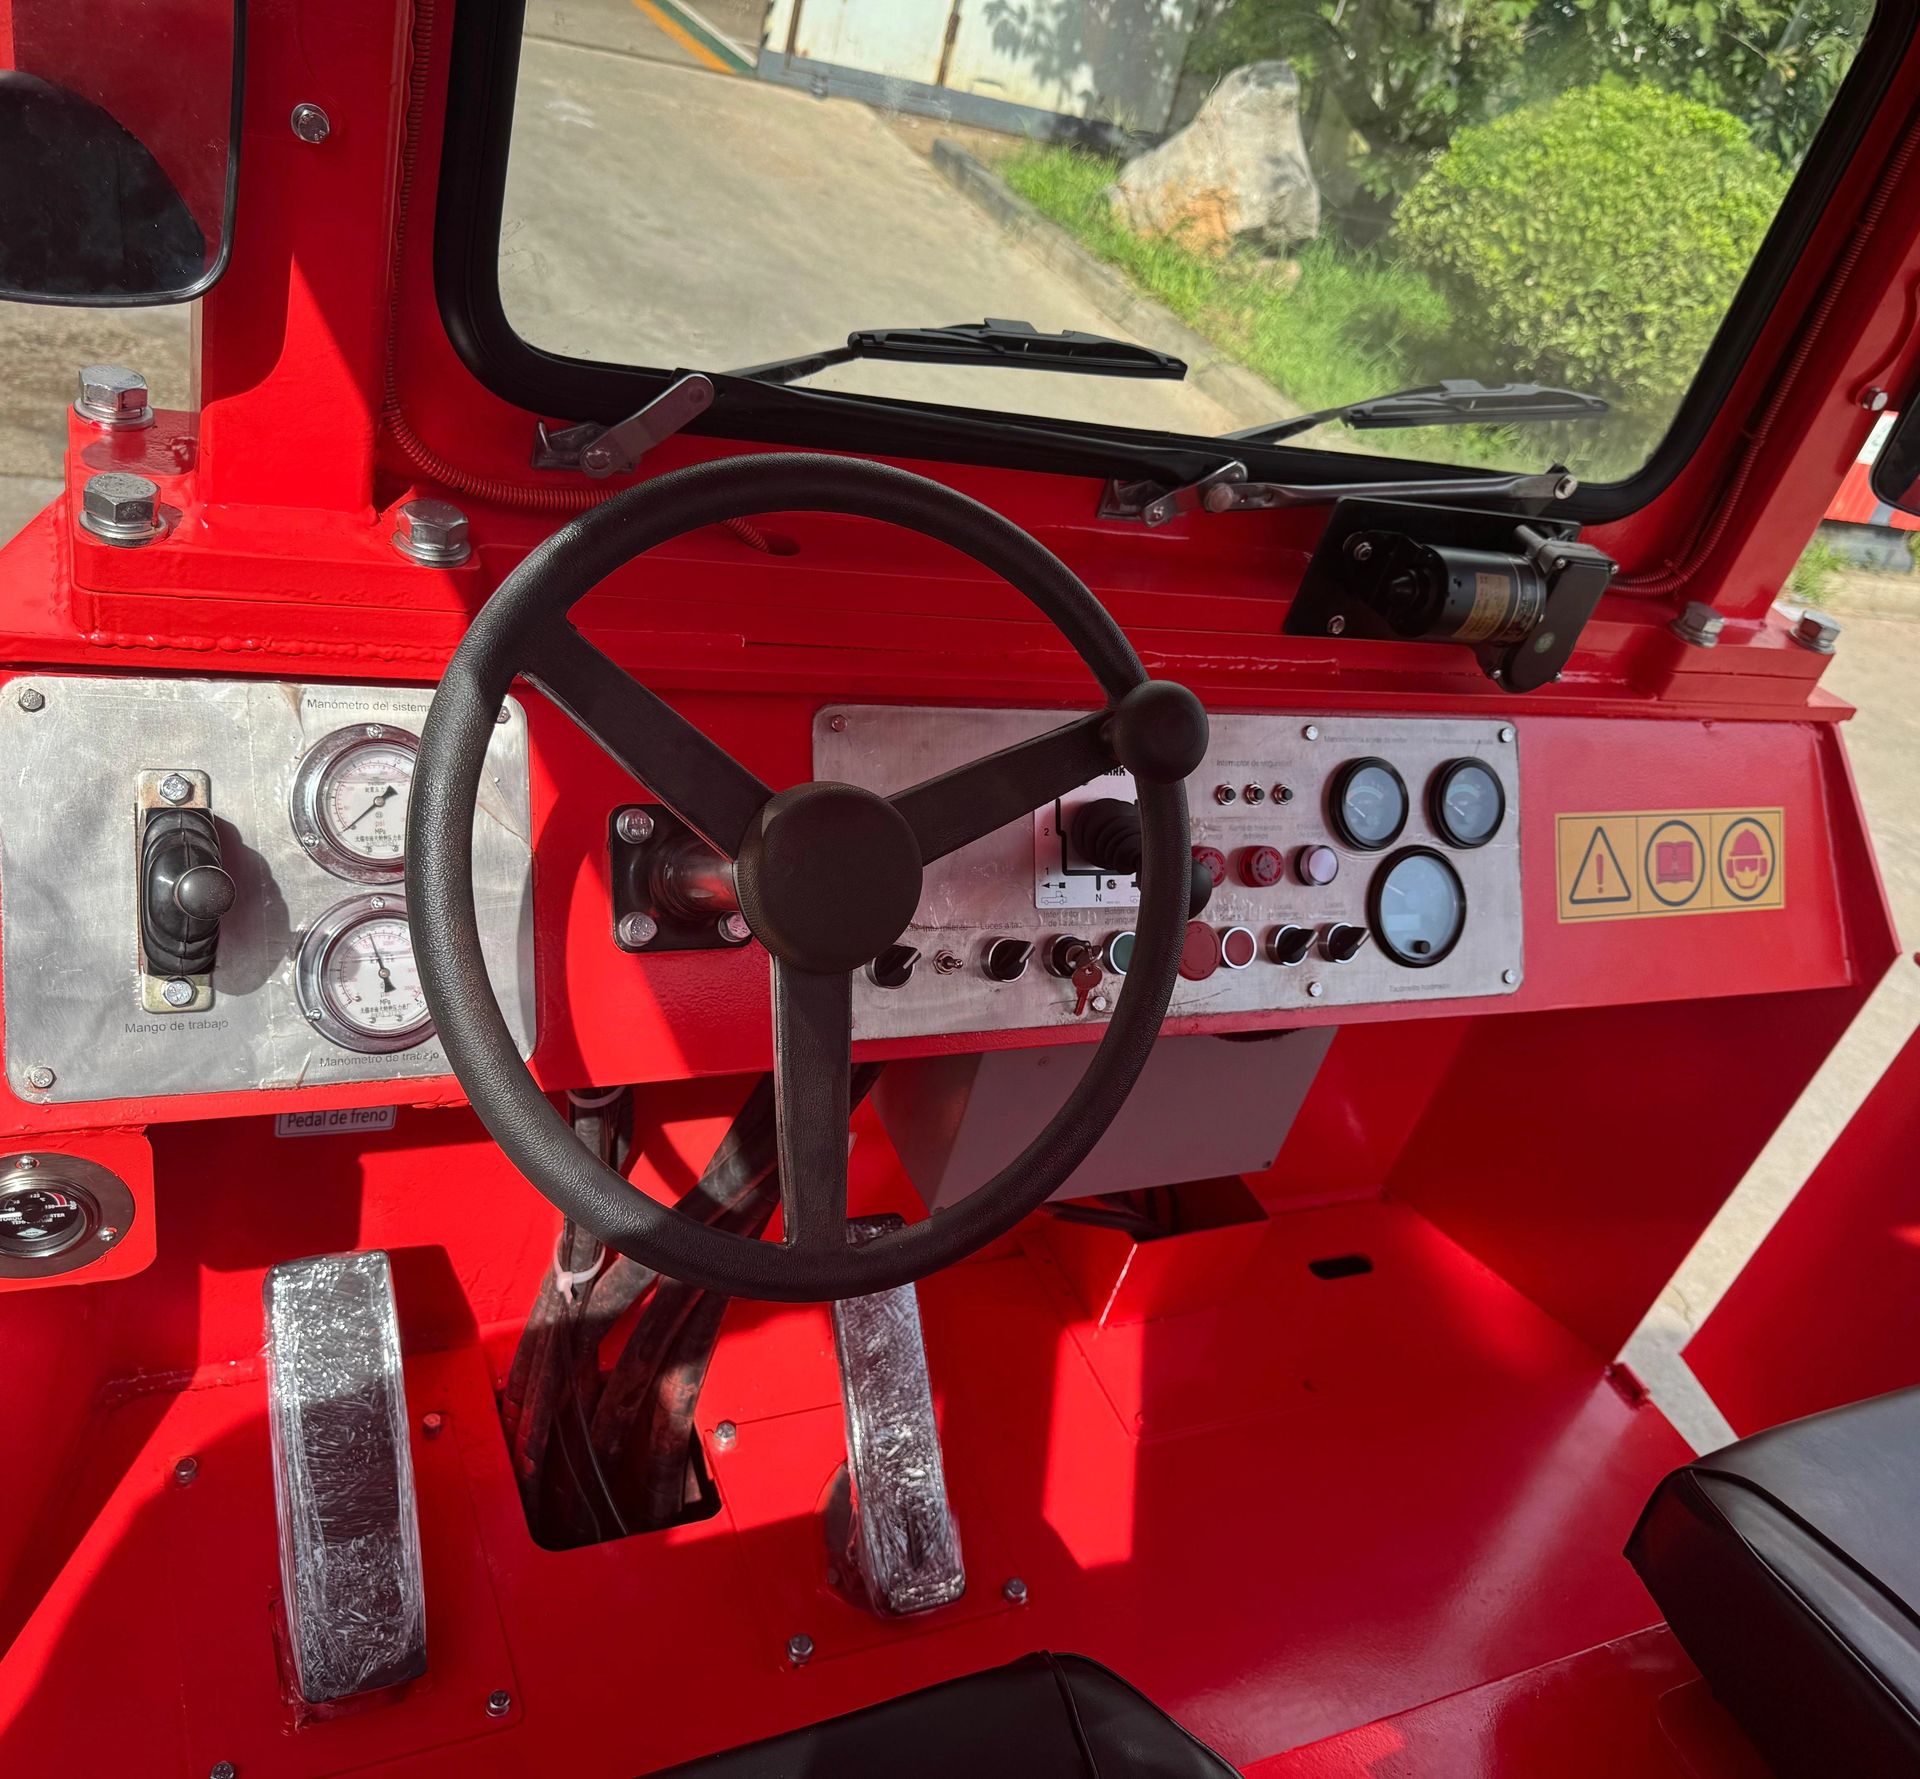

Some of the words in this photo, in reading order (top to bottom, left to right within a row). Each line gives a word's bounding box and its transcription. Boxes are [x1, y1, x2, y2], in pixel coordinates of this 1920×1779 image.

[307, 699, 370, 710] Manómetro
[373, 701, 389, 711] del
[1044, 828, 1050, 836] 2
[1045, 867, 1049, 876] 1
[1095, 894, 1102, 902] N
[125, 1022, 167, 1034] Mango
[169, 1021, 185, 1031] de
[188, 1019, 229, 1031] trabajo
[320, 1055, 382, 1068] Manómetro
[385, 1053, 399, 1064] de
[402, 1050, 440, 1062] trabajo
[287, 1110, 326, 1129] Pedal
[329, 1108, 348, 1126] de
[350, 1108, 388, 1124] freno
